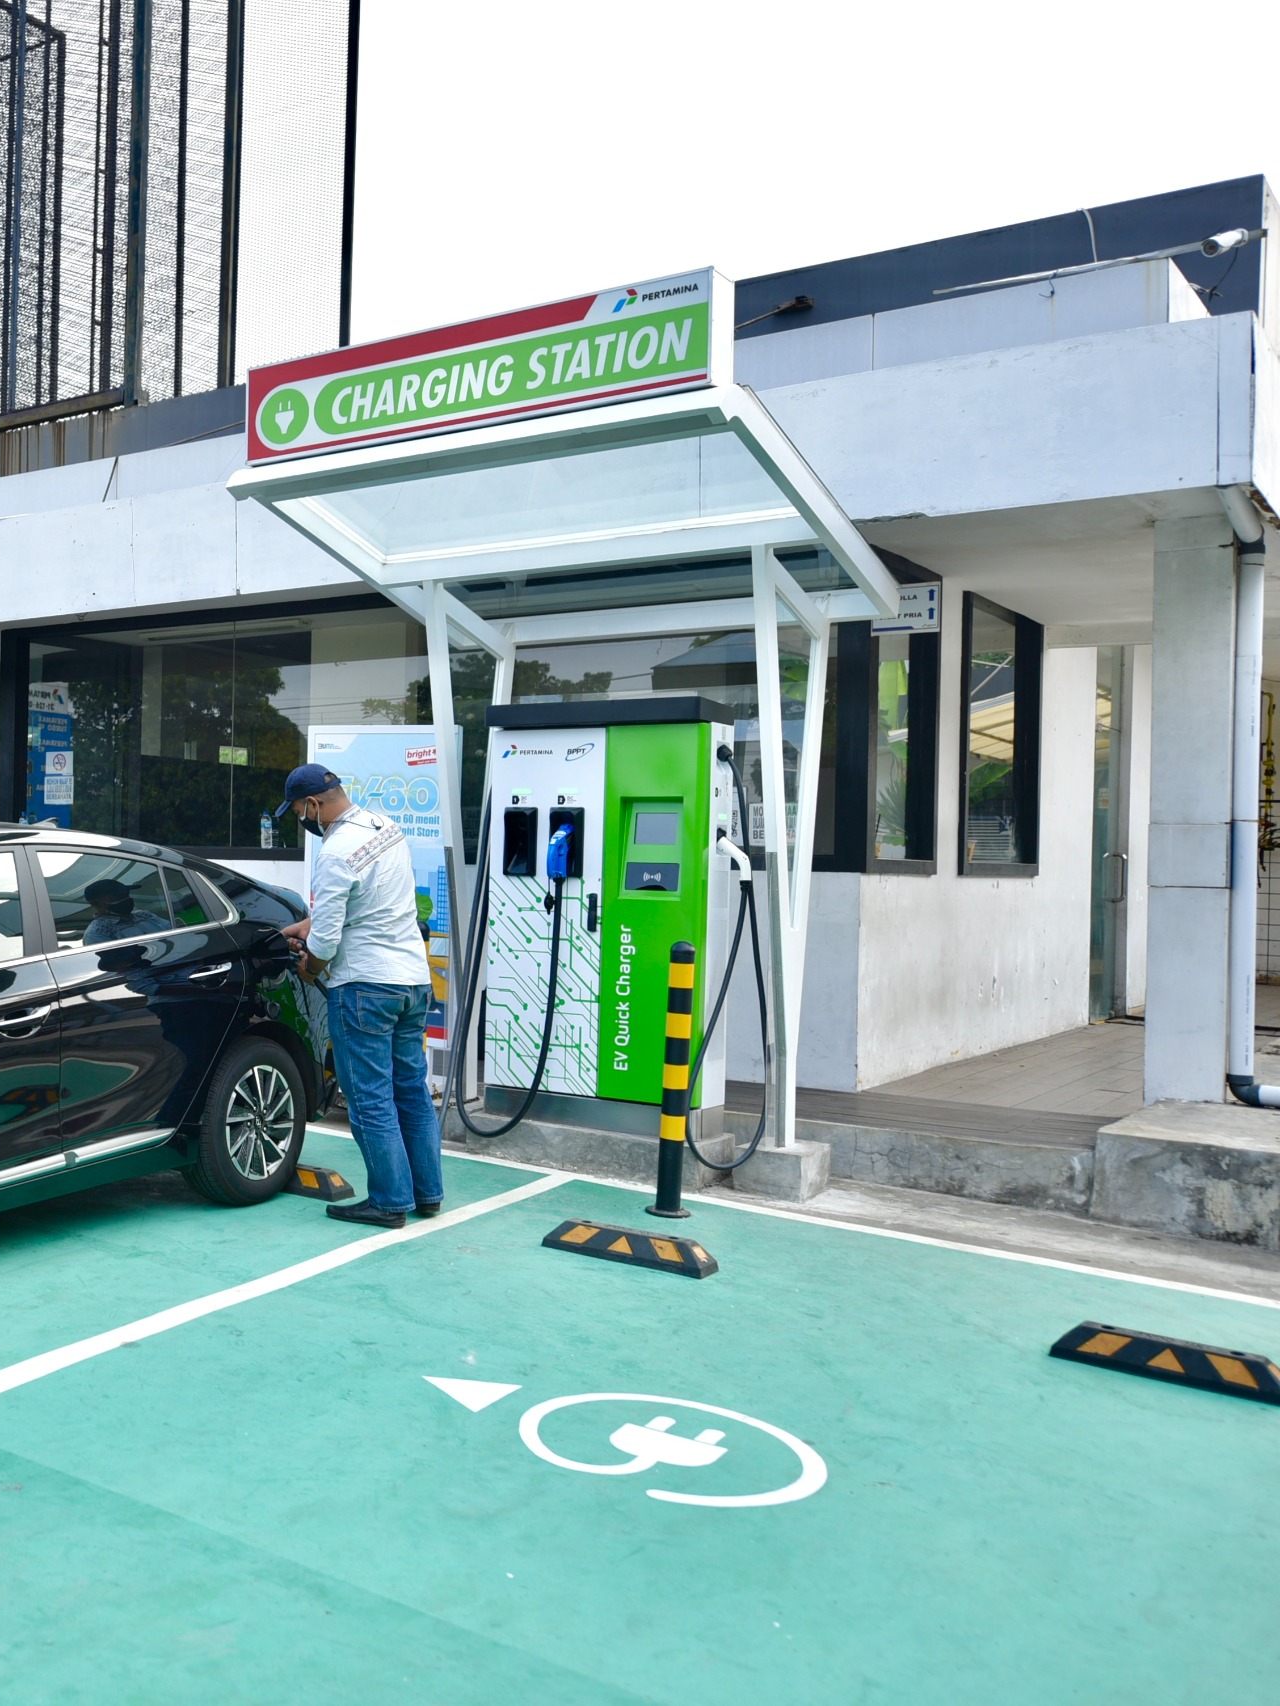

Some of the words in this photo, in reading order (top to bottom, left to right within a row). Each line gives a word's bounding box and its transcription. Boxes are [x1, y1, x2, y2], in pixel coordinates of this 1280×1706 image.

[642, 283, 698, 302] PERTAMINA
[331, 355, 514, 424] CHARGING
[526, 318, 693, 390] STATION
[407, 749, 431, 759] bright
[403, 814, 413, 824] 60
[415, 815, 440, 825] menit
[417, 827, 439, 837] Store
[616, 925, 636, 996] Charger
[615, 1001, 631, 1046] Quick
[614, 1051, 628, 1071] EV
